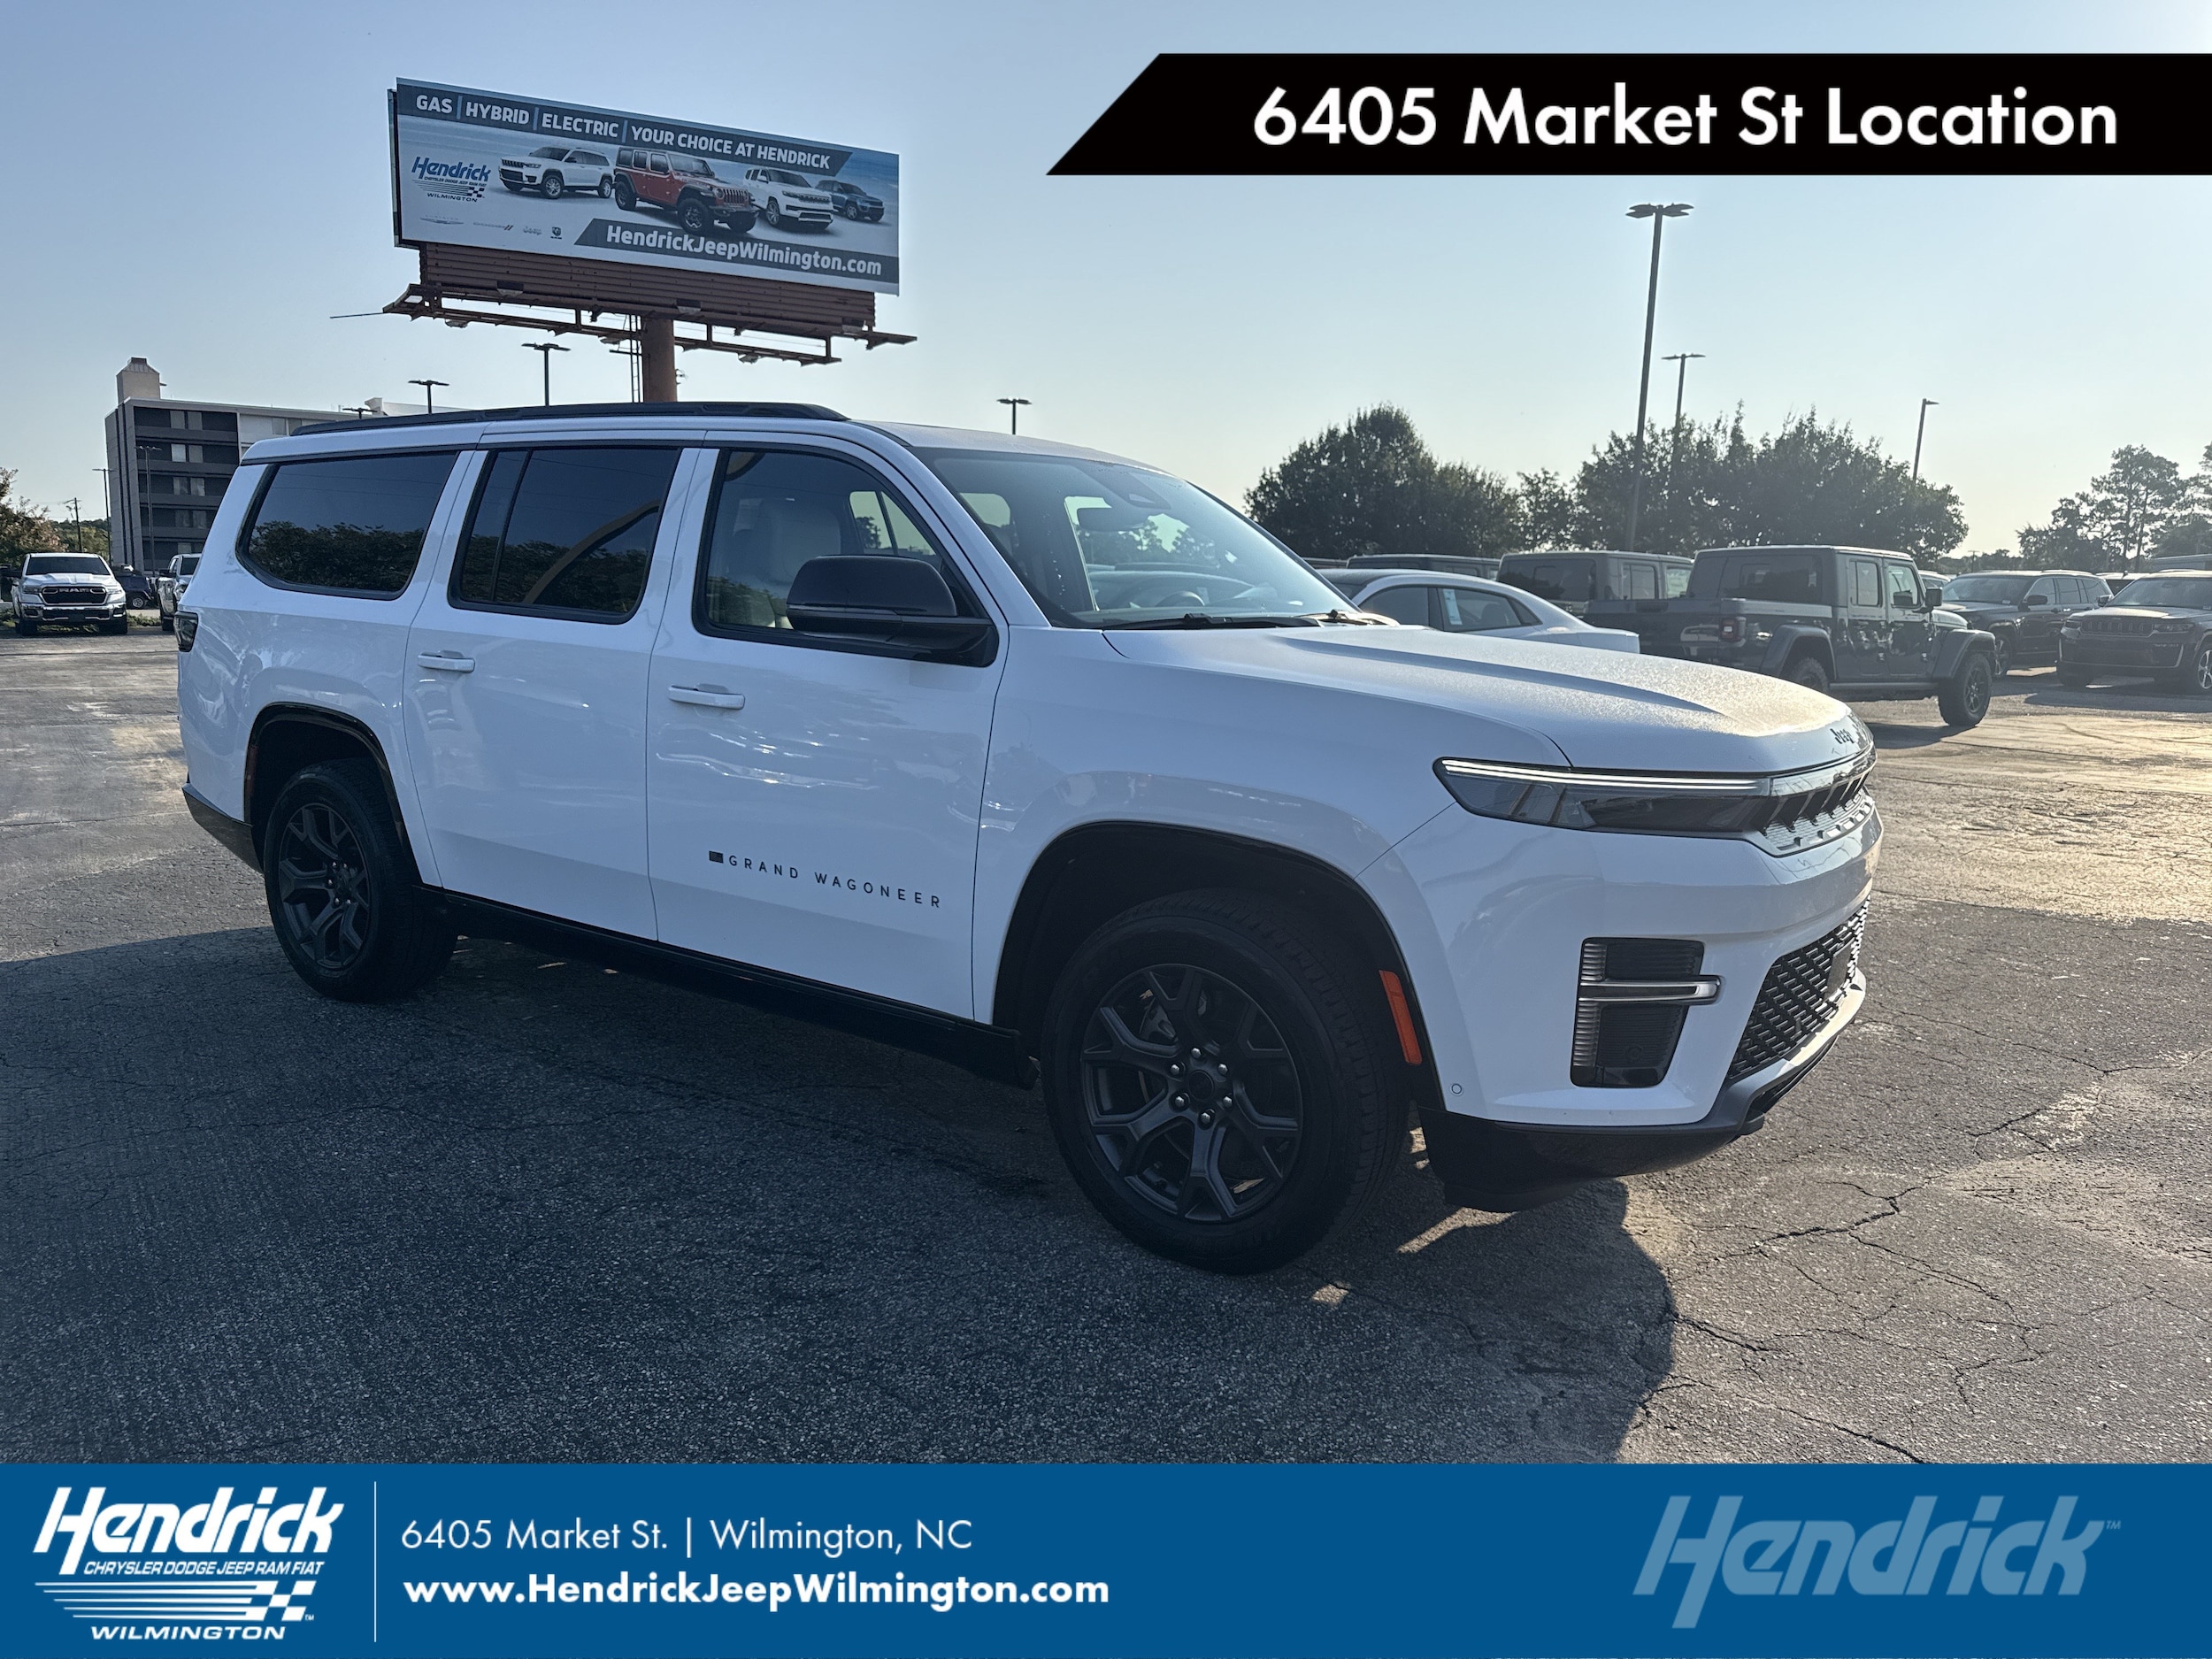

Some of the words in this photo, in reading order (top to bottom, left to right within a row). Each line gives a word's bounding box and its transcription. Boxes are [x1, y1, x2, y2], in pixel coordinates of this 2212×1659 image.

[416, 94, 453, 114] GAS
[465, 101, 530, 125] HYBRID
[541, 112, 619, 137] ELECTRIC
[631, 125, 674, 146] YOUR
[677, 133, 732, 154] CHOICE
[734, 143, 755, 157] AT
[757, 145, 831, 170] HENDRICK
[411, 156, 491, 182] Hendrick
[426, 192, 478, 203] WILMINGTON
[606, 224, 882, 276] HendrickJeepWilmington.com
[728, 855, 798, 879] GRAND
[814, 872, 941, 908] WAGONEER
